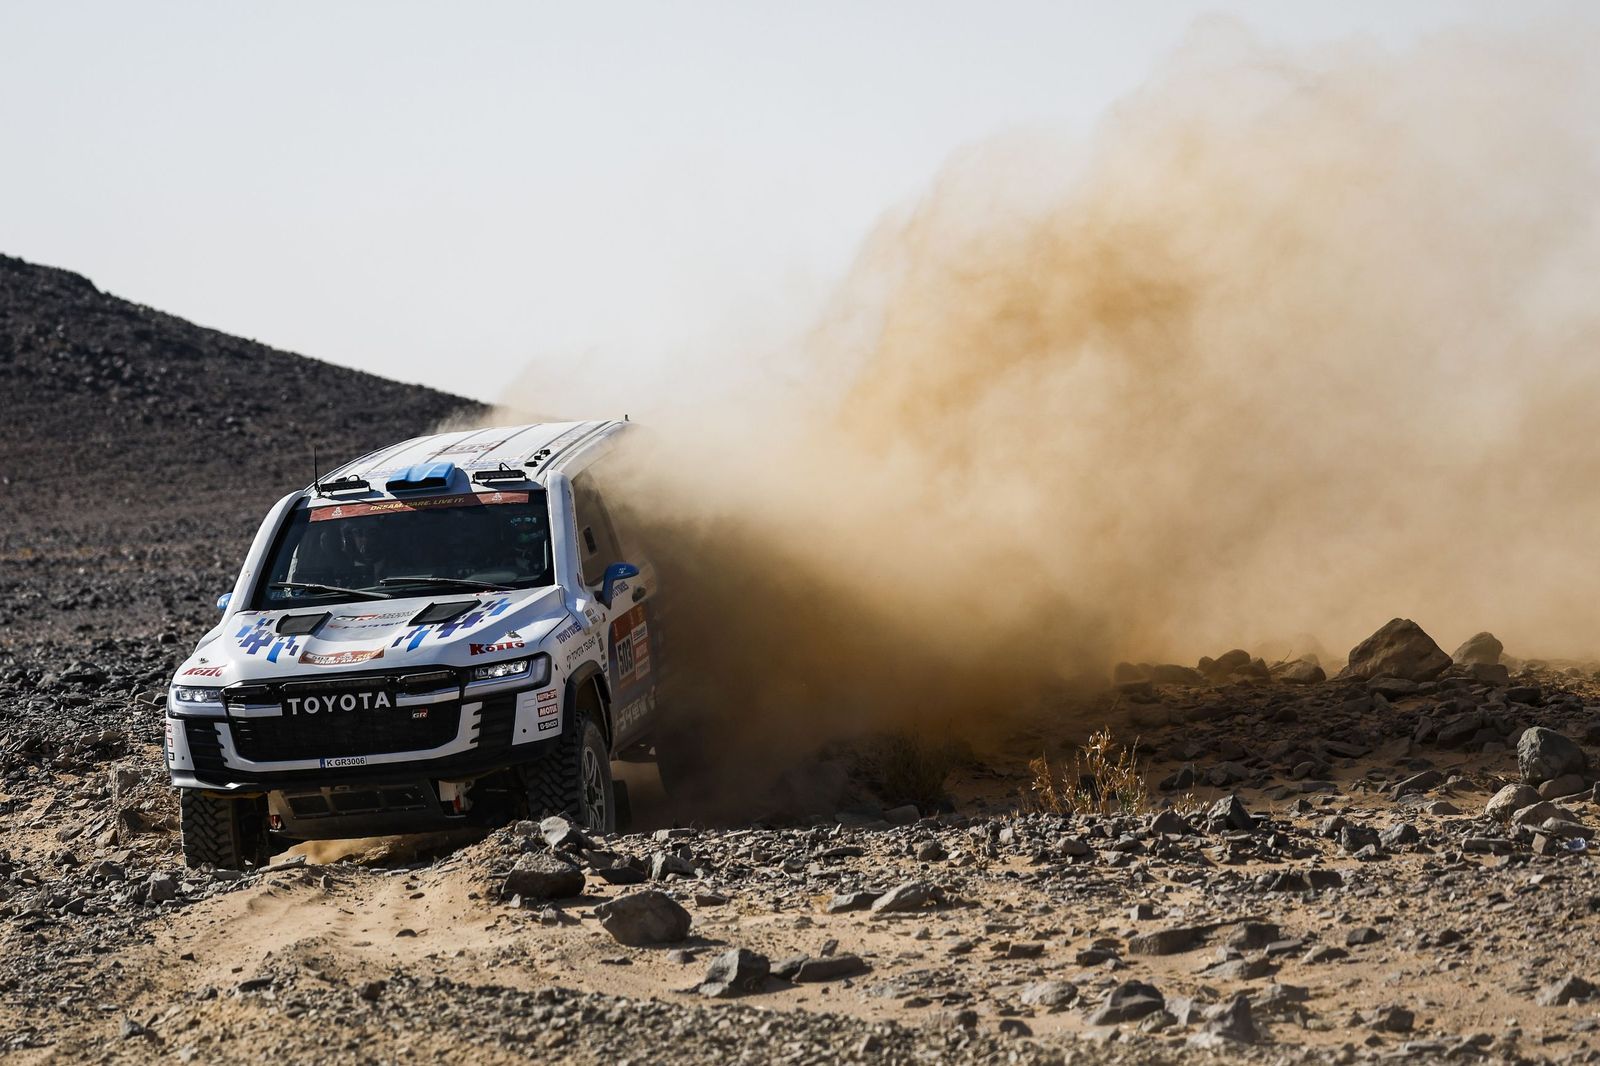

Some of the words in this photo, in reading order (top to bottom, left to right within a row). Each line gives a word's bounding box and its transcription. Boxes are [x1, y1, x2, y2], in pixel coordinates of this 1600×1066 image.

[617, 638, 633, 675] 503
[287, 691, 391, 715] TOYOTA
[539, 704, 558, 716] MOTUL
[326, 759, 333, 767] K
[334, 757, 365, 766] GR3006
